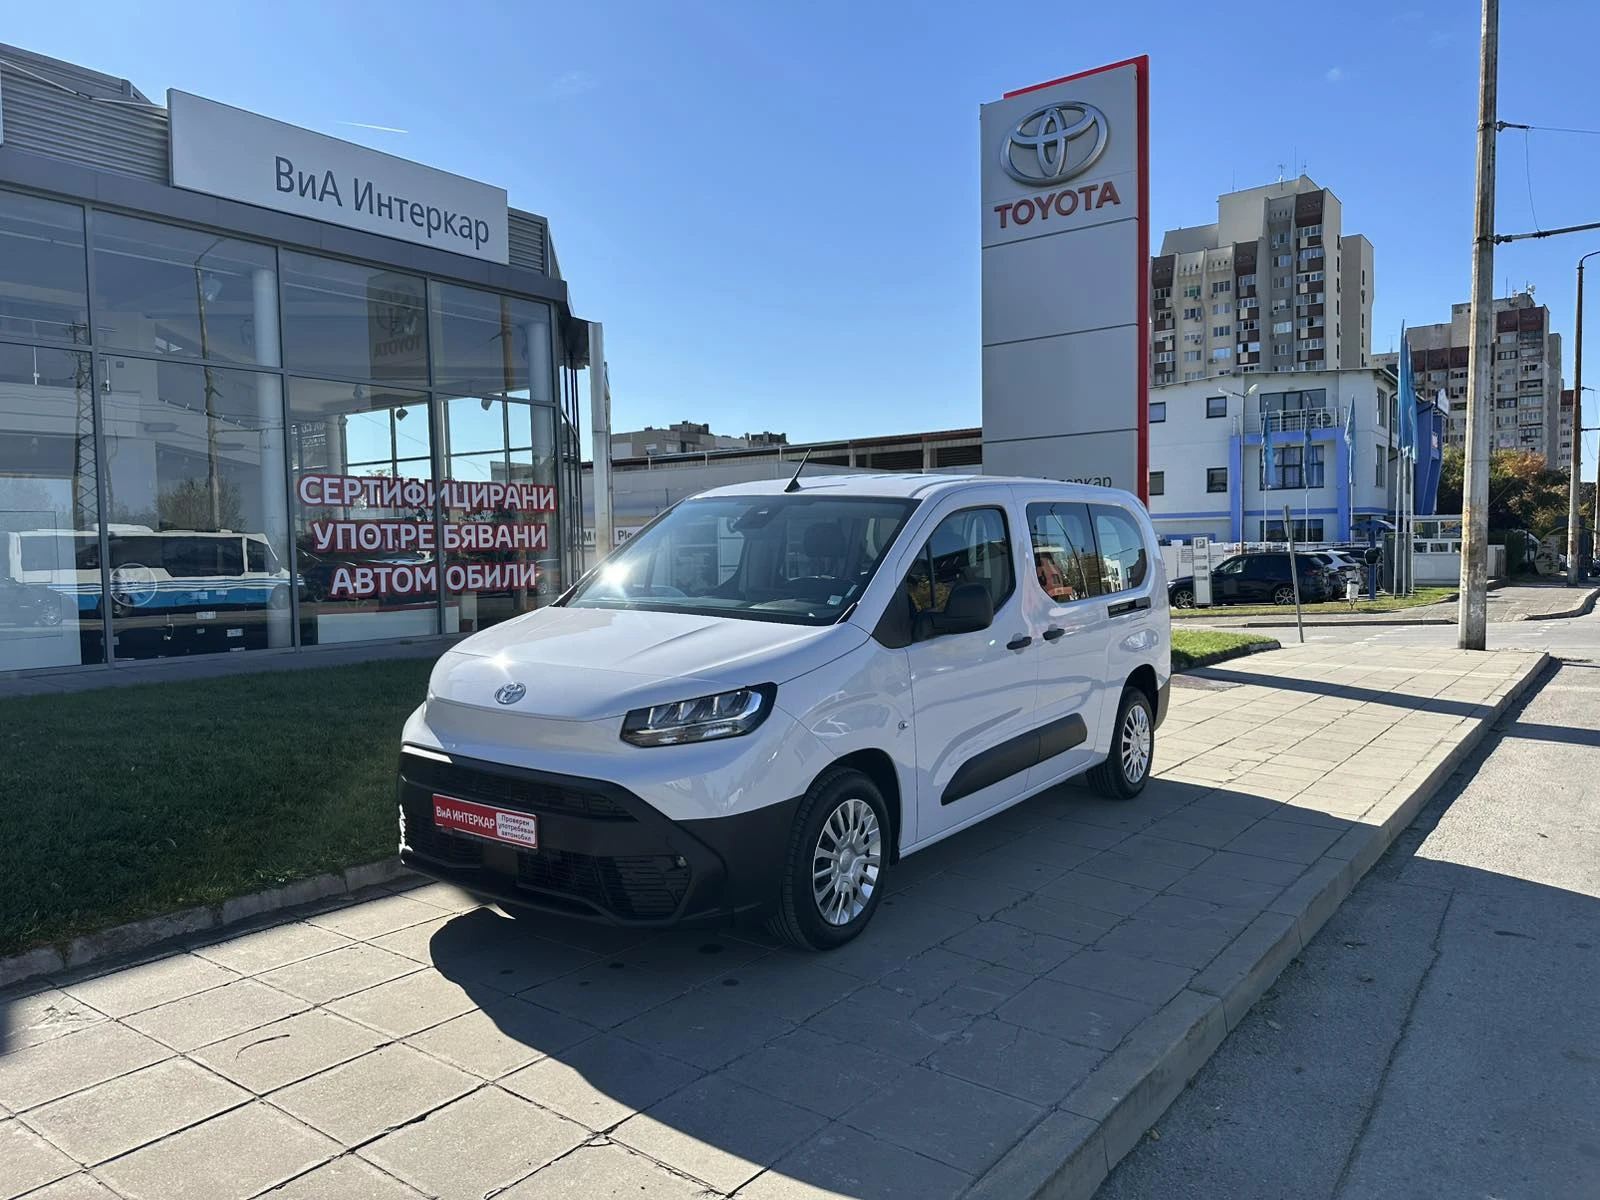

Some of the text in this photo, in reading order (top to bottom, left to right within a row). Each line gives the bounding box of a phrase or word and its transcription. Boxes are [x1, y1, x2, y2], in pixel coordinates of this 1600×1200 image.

[275, 155, 490, 250] ВиА Интеркар
[993, 181, 1121, 229] TOYOTA
[299, 475, 556, 512] СЕРТИФИЦИРАНИ
[435, 805, 496, 830] ВиА ИНТЕРКАР
[501, 814, 530, 826] Проверен
